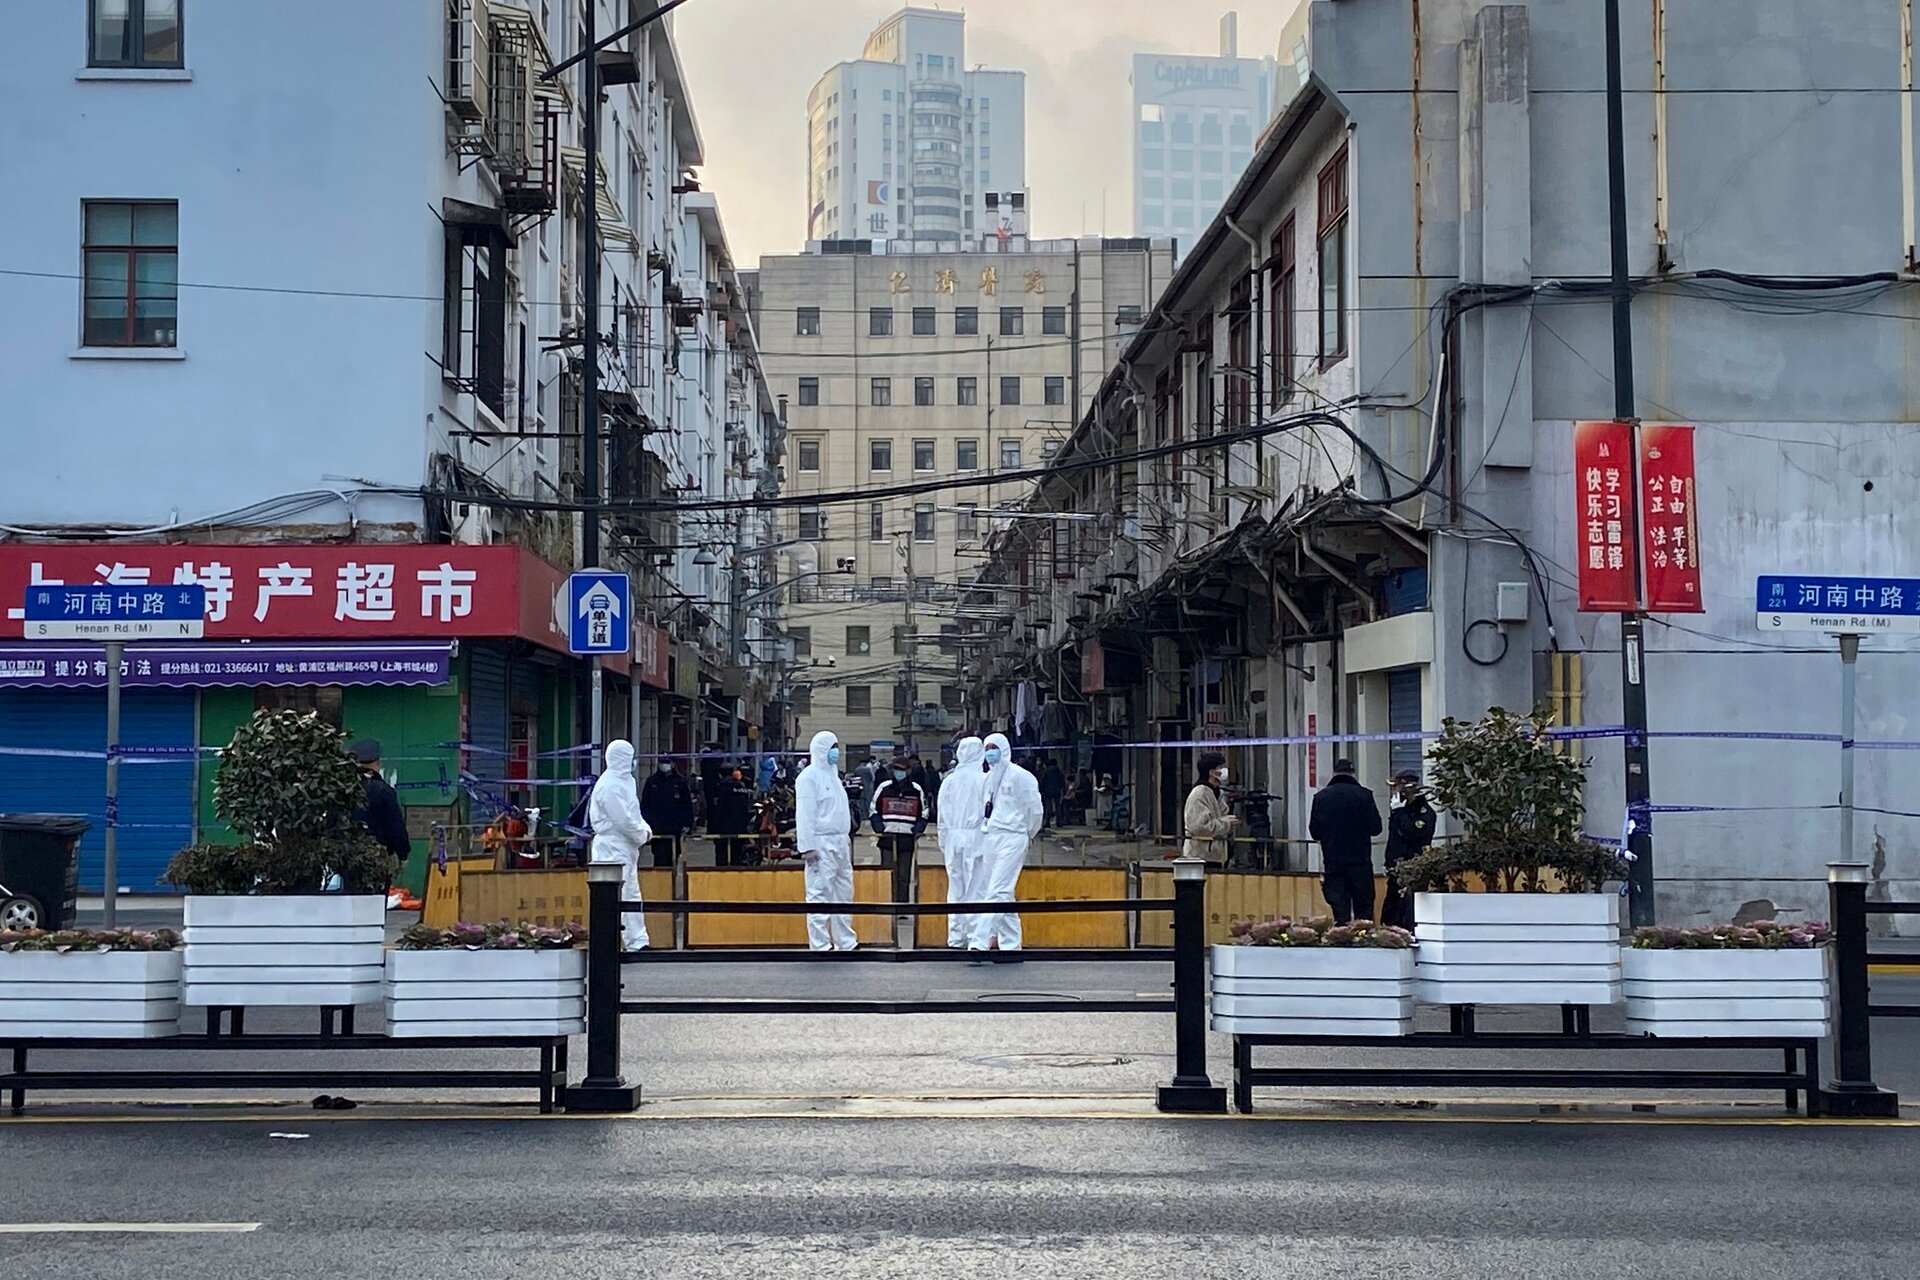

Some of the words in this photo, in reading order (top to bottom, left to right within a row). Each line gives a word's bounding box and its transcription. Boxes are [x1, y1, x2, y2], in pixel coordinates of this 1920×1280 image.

[1648, 475, 1665, 513] 公正
[1669, 475, 1685, 515] 自由
[1586, 467, 1605, 570] 快乐志愿
[1605, 468, 1623, 571] 学习雷锋
[1650, 526, 1667, 568] 法治
[1671, 526, 1687, 570] 平等
[64, 592, 165, 615] 河南中路
[179, 592, 191, 604] 北
[1768, 598, 1786, 608] 221
[1772, 583, 1784, 597] 南
[1798, 583, 1904, 609] 河南中路
[38, 624, 48, 635] S
[75, 624, 110, 634] Henan
[180, 624, 189, 634] N
[591, 610, 608, 644] 单行道
[1772, 616, 1782, 627] S
[1810, 617, 1846, 627] Henan
